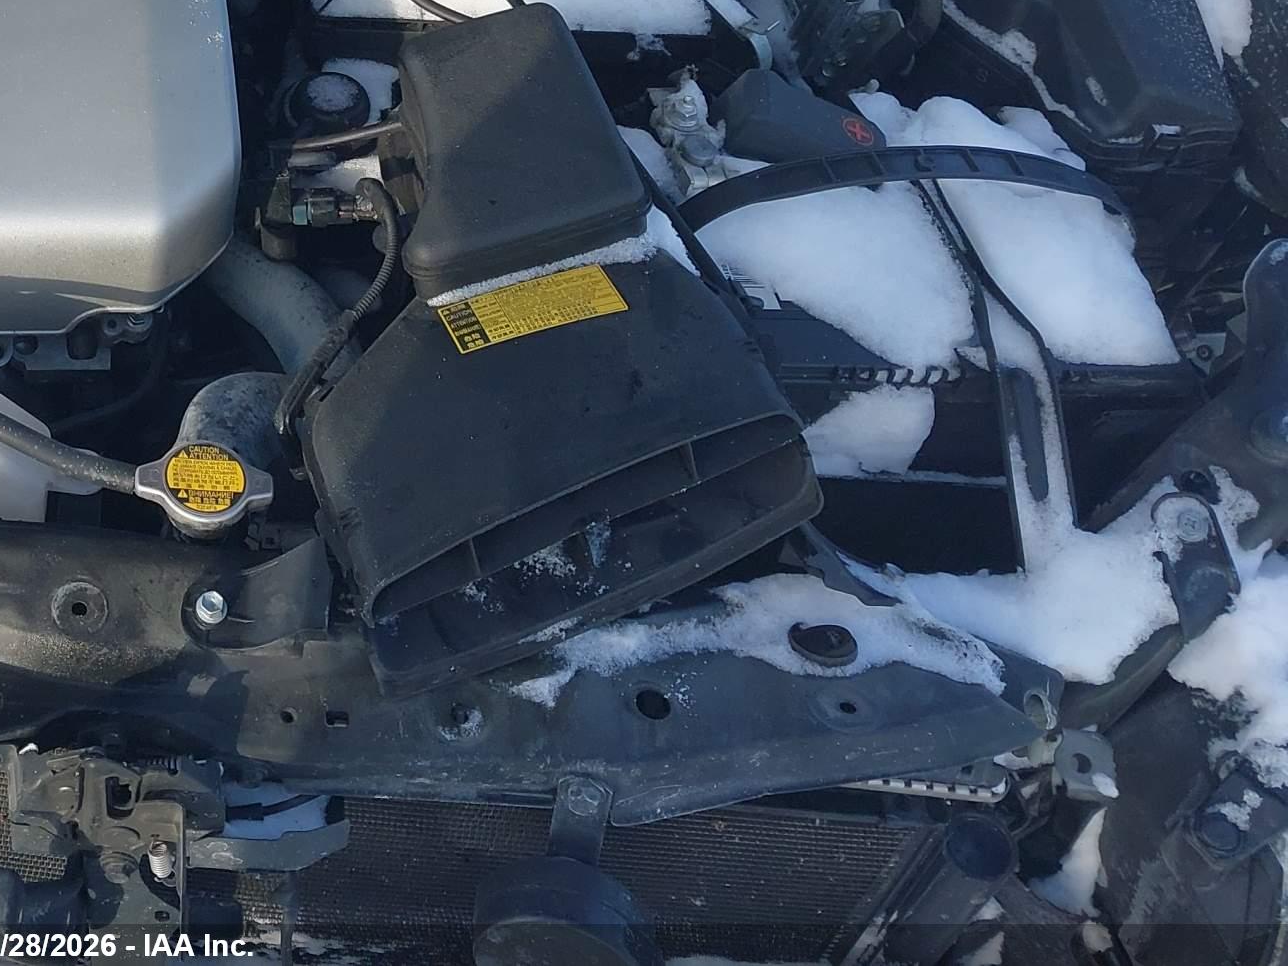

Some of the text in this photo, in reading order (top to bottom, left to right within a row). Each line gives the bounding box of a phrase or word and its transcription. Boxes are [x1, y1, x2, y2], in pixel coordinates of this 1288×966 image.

[446, 310, 473, 321] CAUTION
[189, 446, 219, 454] CAUTION
[190, 452, 228, 460] ATTENTION
